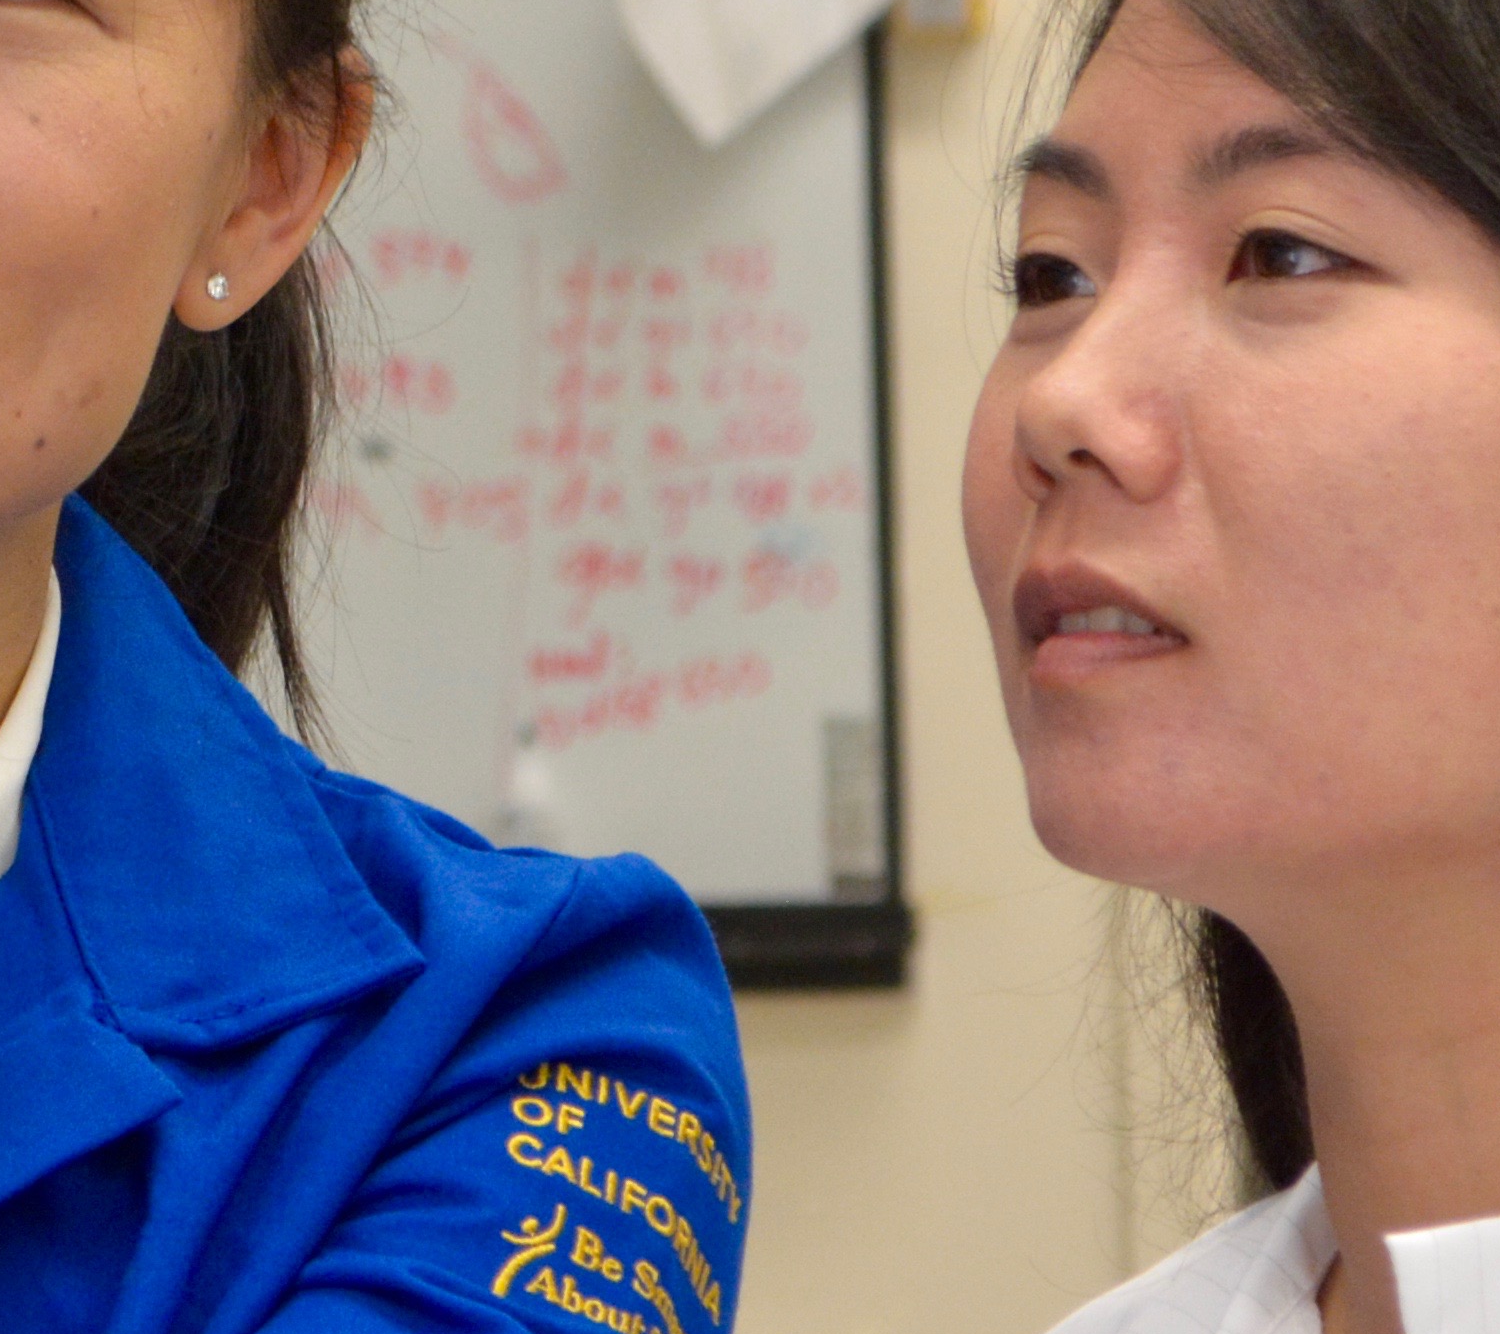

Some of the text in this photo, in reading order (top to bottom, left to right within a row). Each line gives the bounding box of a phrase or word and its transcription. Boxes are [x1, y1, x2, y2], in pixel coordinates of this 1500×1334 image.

[511, 1096, 586, 1135] OF
[518, 1063, 742, 1224] UNIVERSITY
[505, 1133, 722, 1327] CALIFORNIA
[569, 1225, 625, 1283] Be
